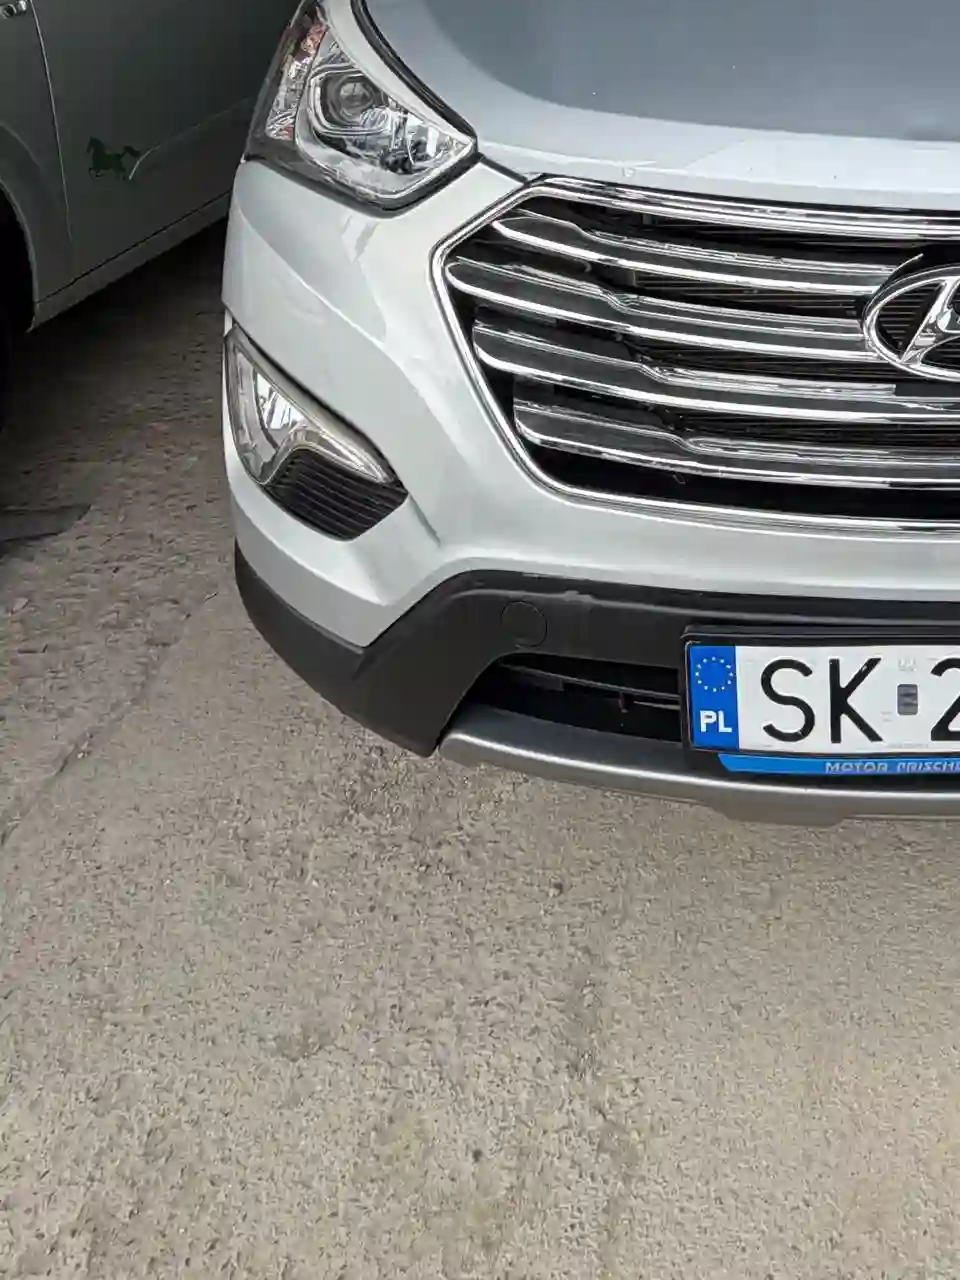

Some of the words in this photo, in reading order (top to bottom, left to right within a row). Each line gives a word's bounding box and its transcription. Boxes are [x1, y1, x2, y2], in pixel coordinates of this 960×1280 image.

[760, 657, 884, 744] SK
[699, 710, 732, 733] PL
[825, 761, 888, 773] MOTOR
